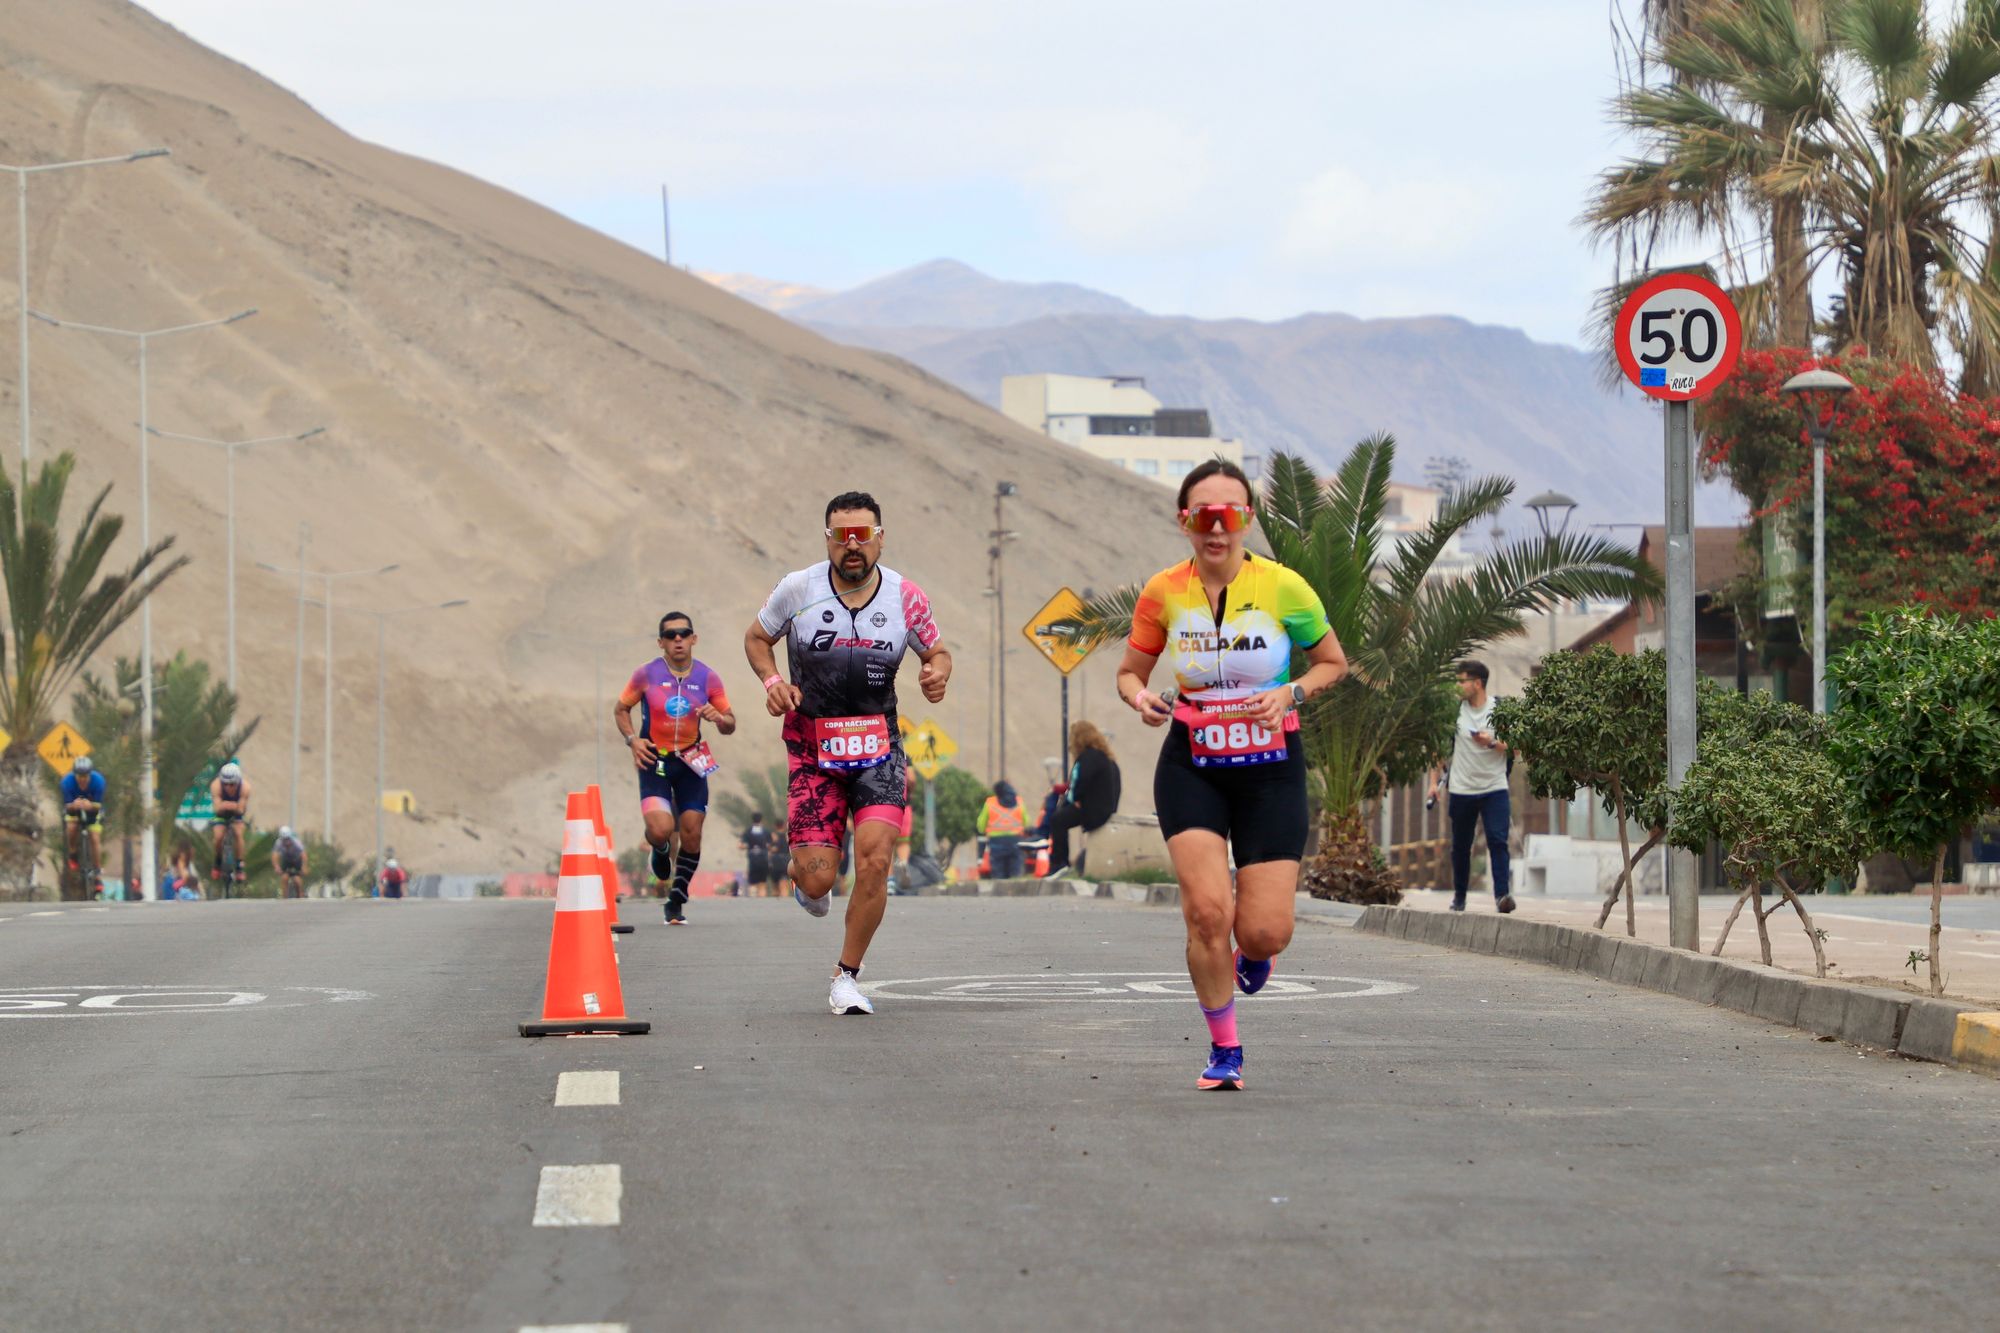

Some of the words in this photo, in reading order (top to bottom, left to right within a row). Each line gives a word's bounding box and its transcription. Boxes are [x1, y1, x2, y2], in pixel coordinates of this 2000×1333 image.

[1640, 308, 1718, 365] 50
[834, 638, 893, 652] FORZA
[1178, 636, 1267, 652] CALAMA
[845, 719, 880, 727] NACIONAL
[830, 734, 878, 757] 088
[1204, 721, 1272, 751] 080
